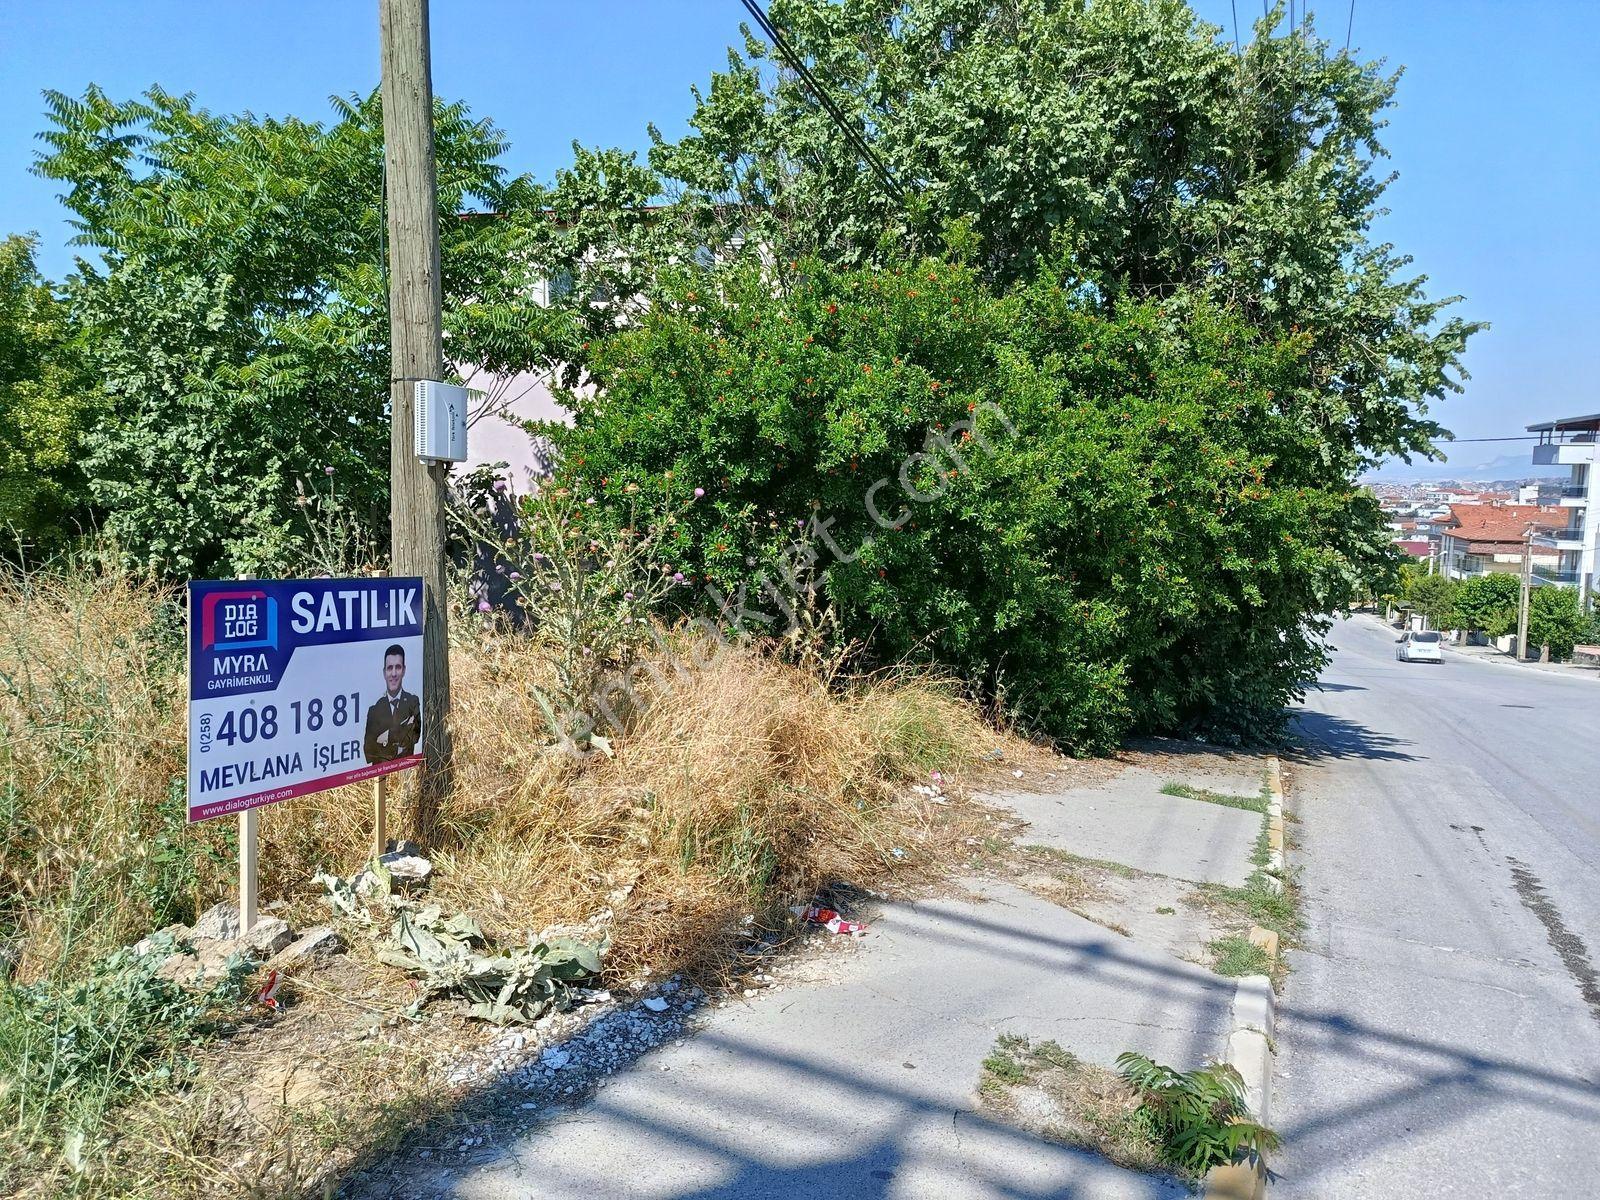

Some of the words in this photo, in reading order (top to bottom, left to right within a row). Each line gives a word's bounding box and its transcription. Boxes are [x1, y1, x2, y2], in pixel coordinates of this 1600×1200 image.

[225, 603, 258, 621] DIA
[290, 588, 418, 634] SATILIK
[225, 620, 258, 638] LOG
[213, 653, 269, 676] MYRA
[207, 674, 274, 690] GAYRİMENKUL
[200, 712, 213, 753] 0(258)
[216, 704, 279, 747] 408
[290, 698, 324, 735] 18
[332, 691, 361, 727] 81
[200, 751, 304, 793] MEVLANA
[313, 739, 361, 772] İŞLER
[202, 788, 293, 816] www.dialogturkiye.com
